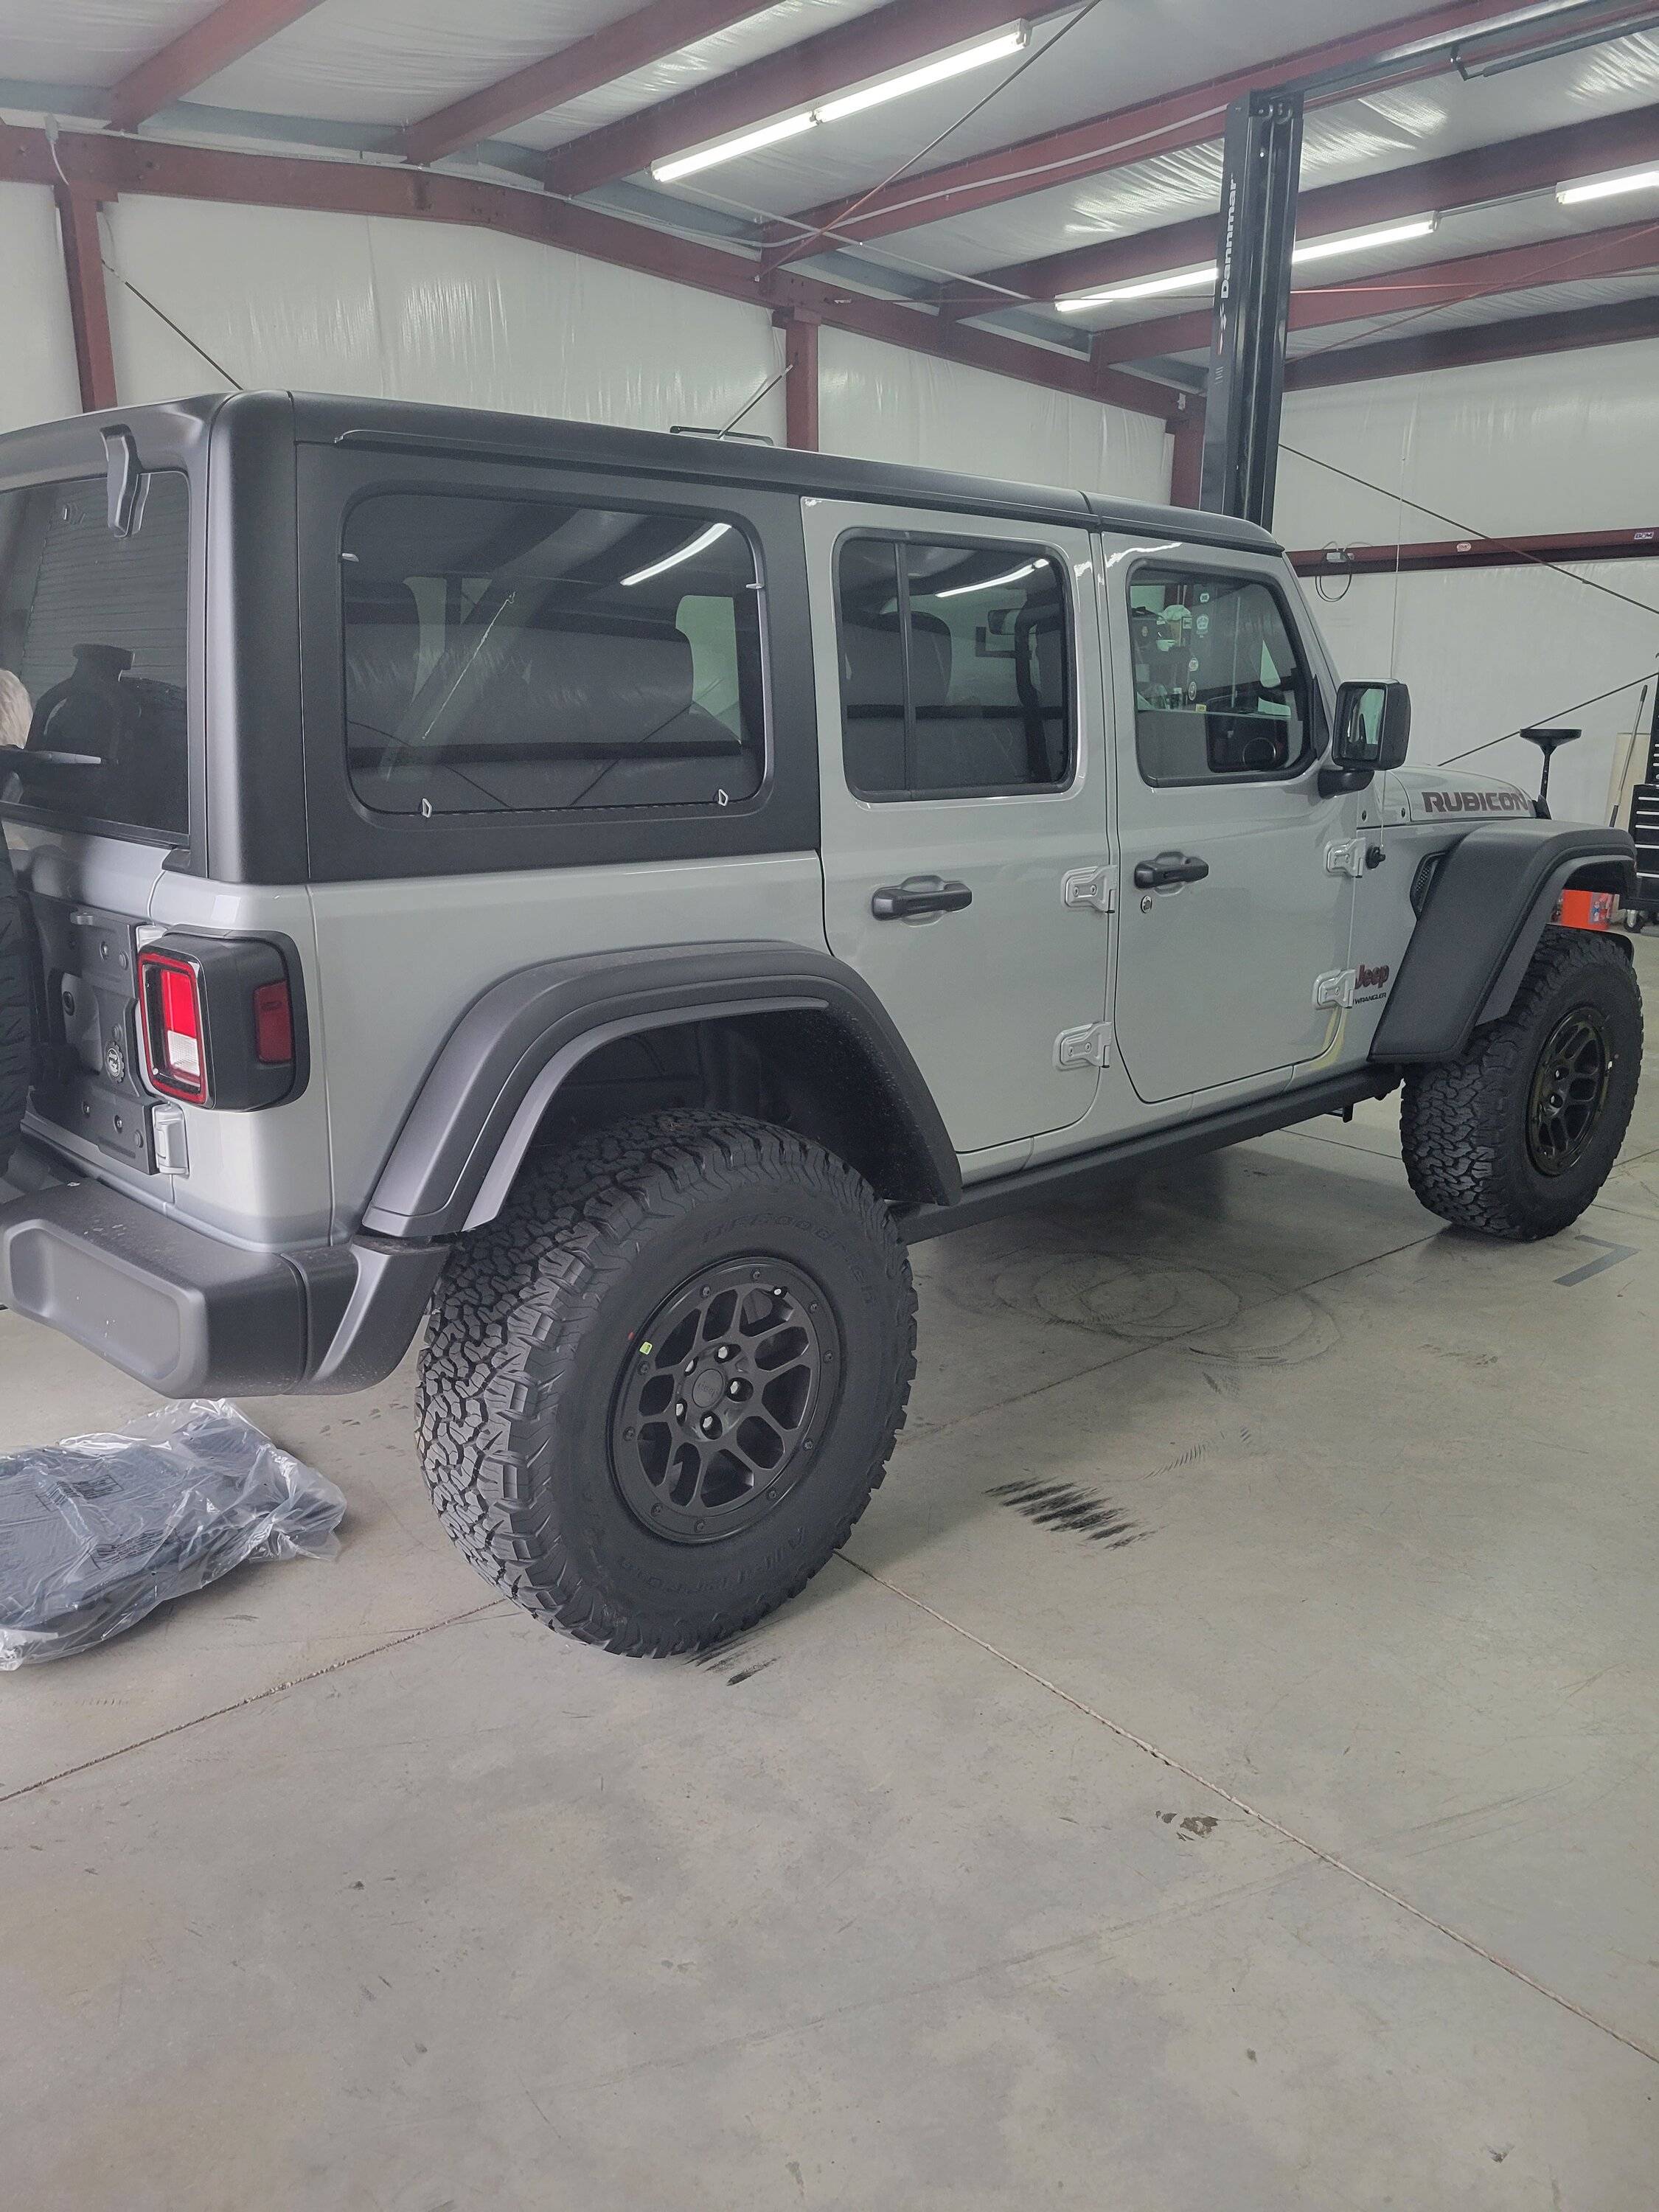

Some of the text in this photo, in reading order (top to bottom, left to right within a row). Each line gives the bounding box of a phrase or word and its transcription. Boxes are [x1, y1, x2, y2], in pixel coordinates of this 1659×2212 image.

[1220, 178, 1237, 299] Dannmar
[1422, 791, 1528, 813] RUBICON
[1354, 964, 1390, 990] Jeep
